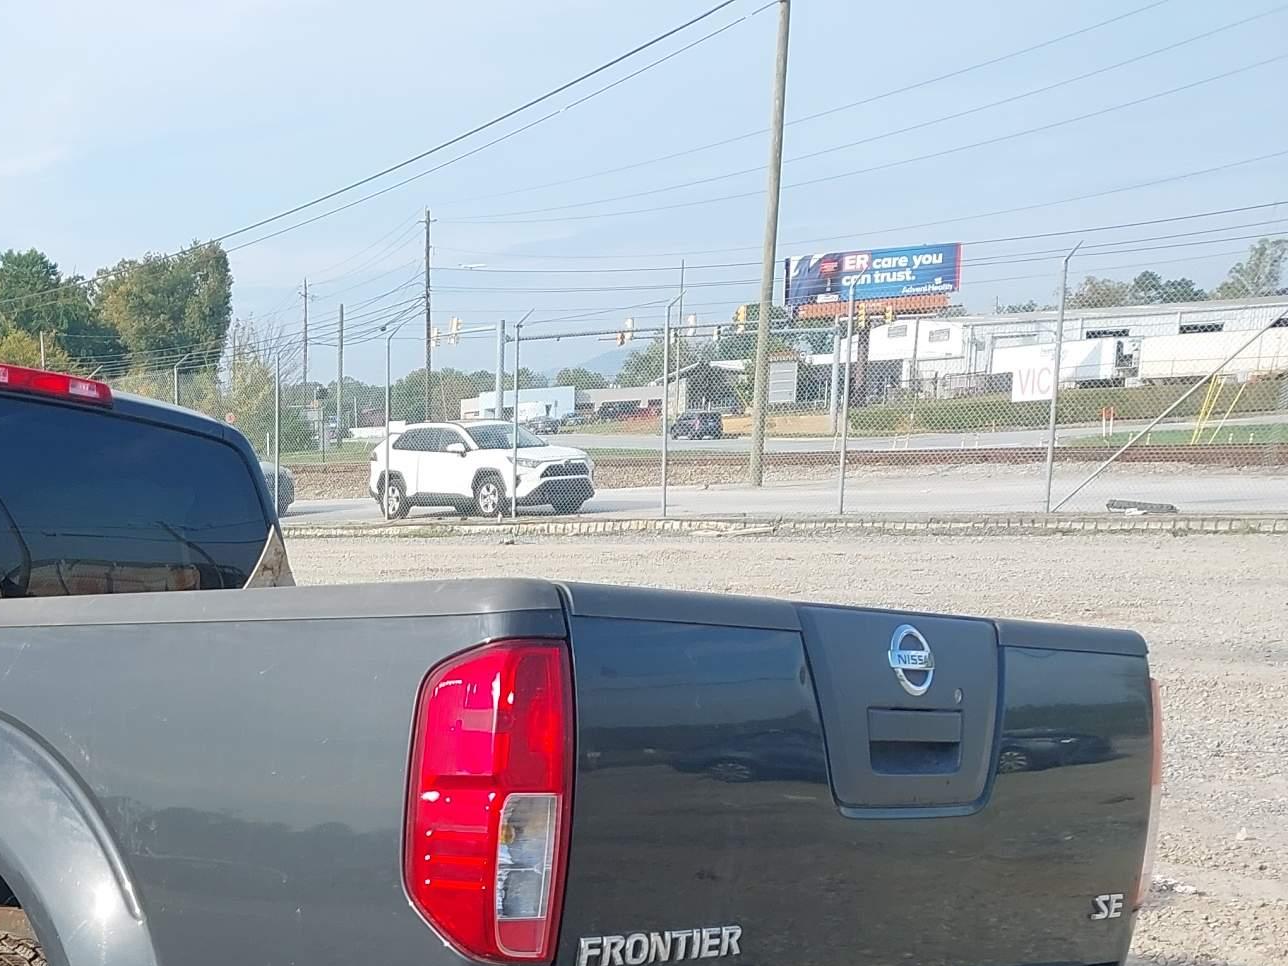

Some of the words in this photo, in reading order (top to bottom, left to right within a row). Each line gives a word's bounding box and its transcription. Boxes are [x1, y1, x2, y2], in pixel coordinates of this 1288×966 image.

[842, 253, 870, 270] ER
[872, 255, 909, 269] care
[912, 252, 943, 269] you
[842, 274, 871, 286] can
[873, 267, 916, 284] trust.
[1018, 366, 1051, 396] VIC
[1090, 893, 1124, 920] SE
